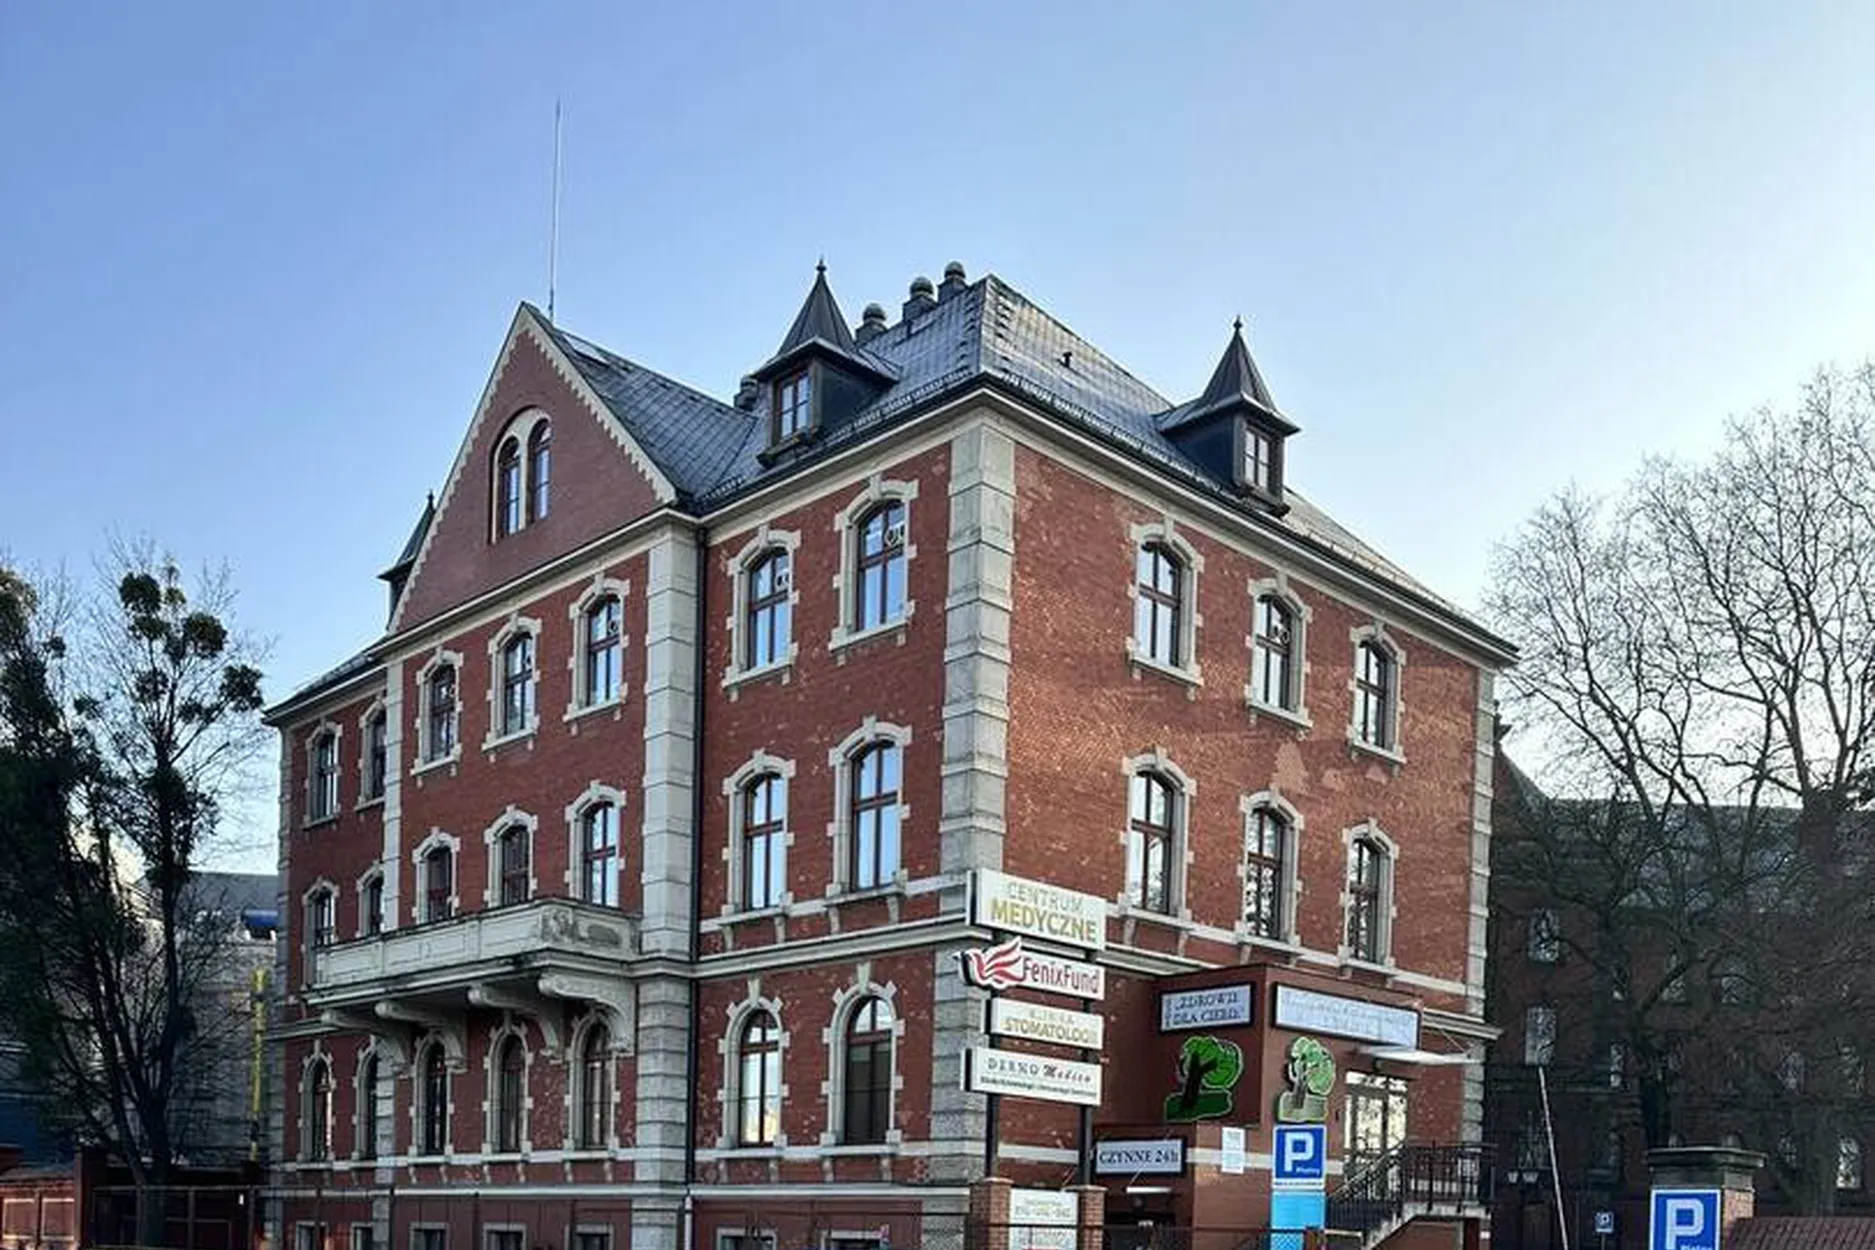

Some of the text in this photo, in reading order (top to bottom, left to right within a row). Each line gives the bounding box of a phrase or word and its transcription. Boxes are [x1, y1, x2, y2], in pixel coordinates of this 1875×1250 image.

[1007, 881, 1083, 911] CENTRUM
[991, 899, 1097, 944] MEDYCZNE
[1022, 957, 1099, 995] FenixFund
[1099, 1149, 1178, 1164] CZYNNE 24h
[1284, 1131, 1315, 1172] P
[1665, 1198, 1704, 1250] P
